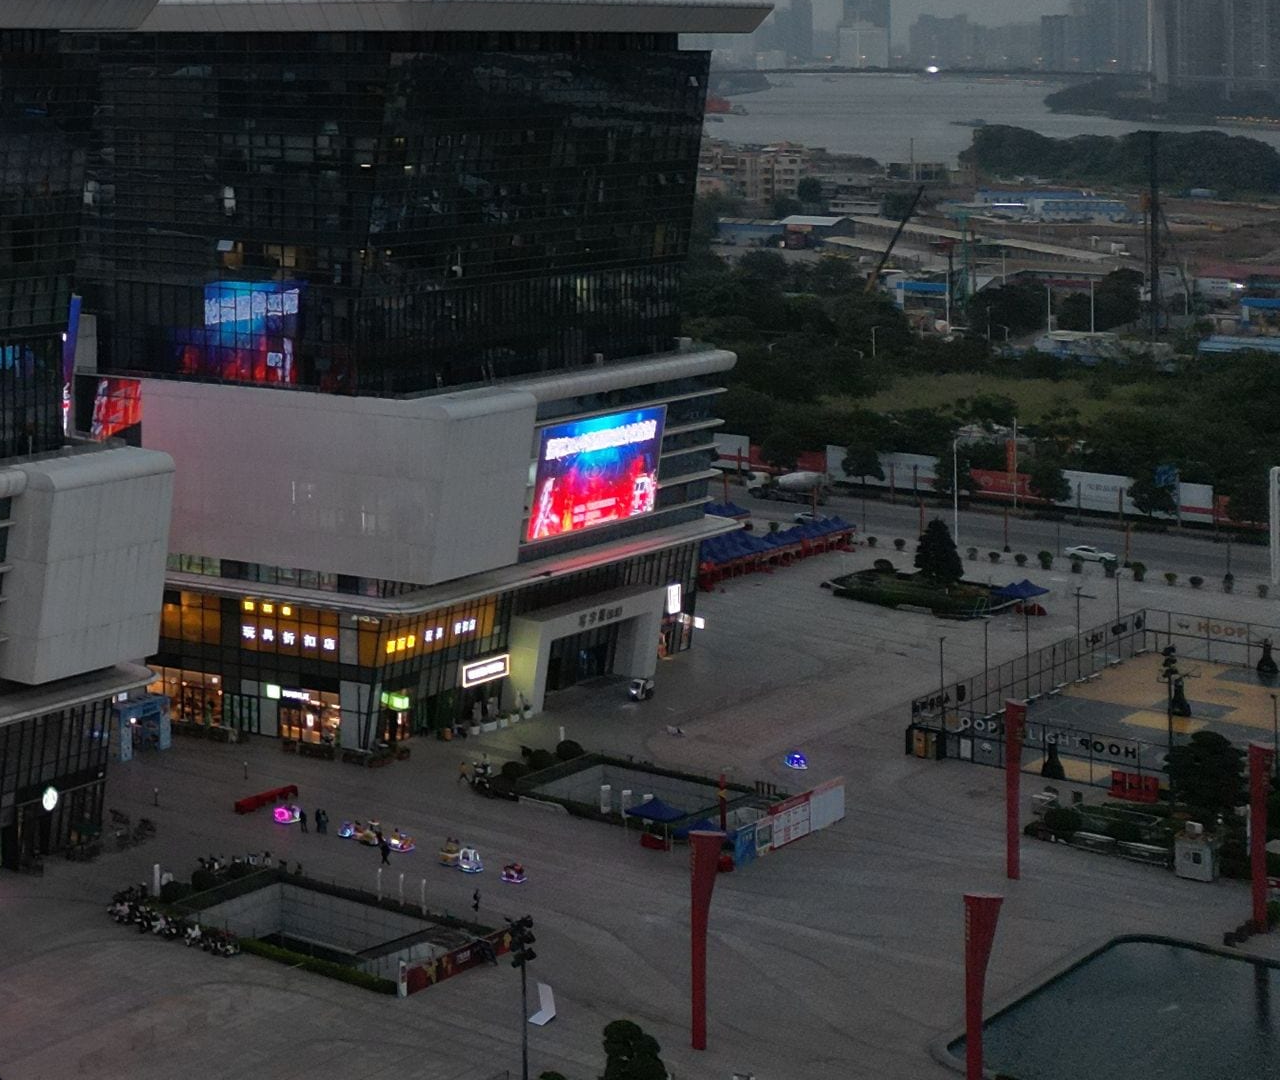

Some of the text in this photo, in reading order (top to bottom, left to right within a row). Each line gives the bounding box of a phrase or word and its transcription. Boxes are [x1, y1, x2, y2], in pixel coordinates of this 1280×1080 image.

[242, 625, 336, 651] 玩具折扣店
